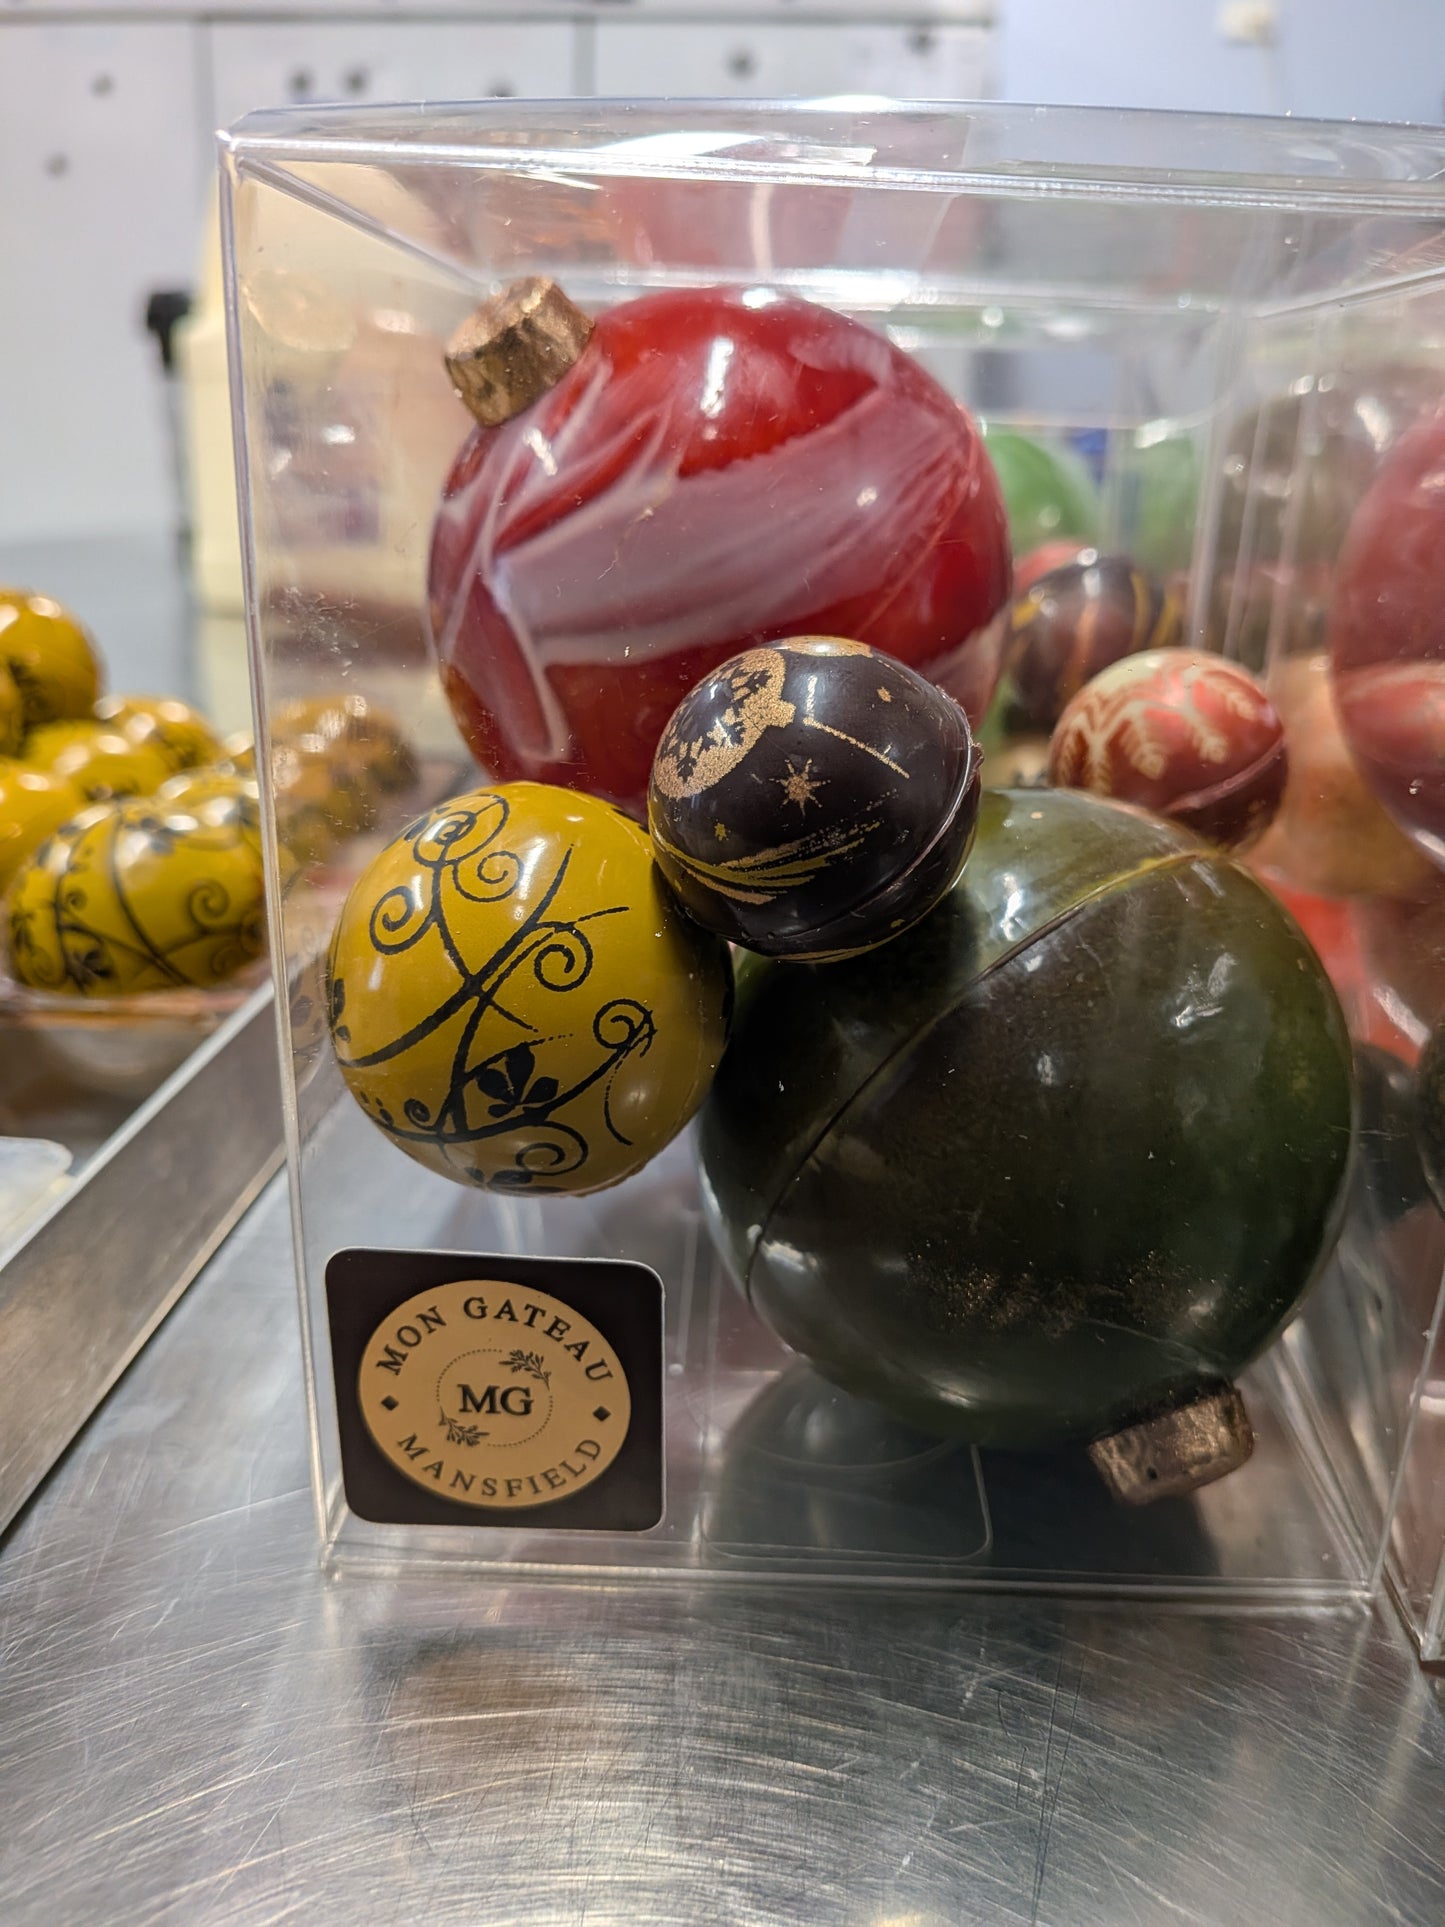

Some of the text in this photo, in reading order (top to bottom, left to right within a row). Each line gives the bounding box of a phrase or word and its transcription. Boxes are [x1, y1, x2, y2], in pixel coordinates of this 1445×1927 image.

[376, 1297, 613, 1382] MON GATEAU
[457, 1384, 534, 1416] MG
[398, 1433, 600, 1497] MANSFIELD
